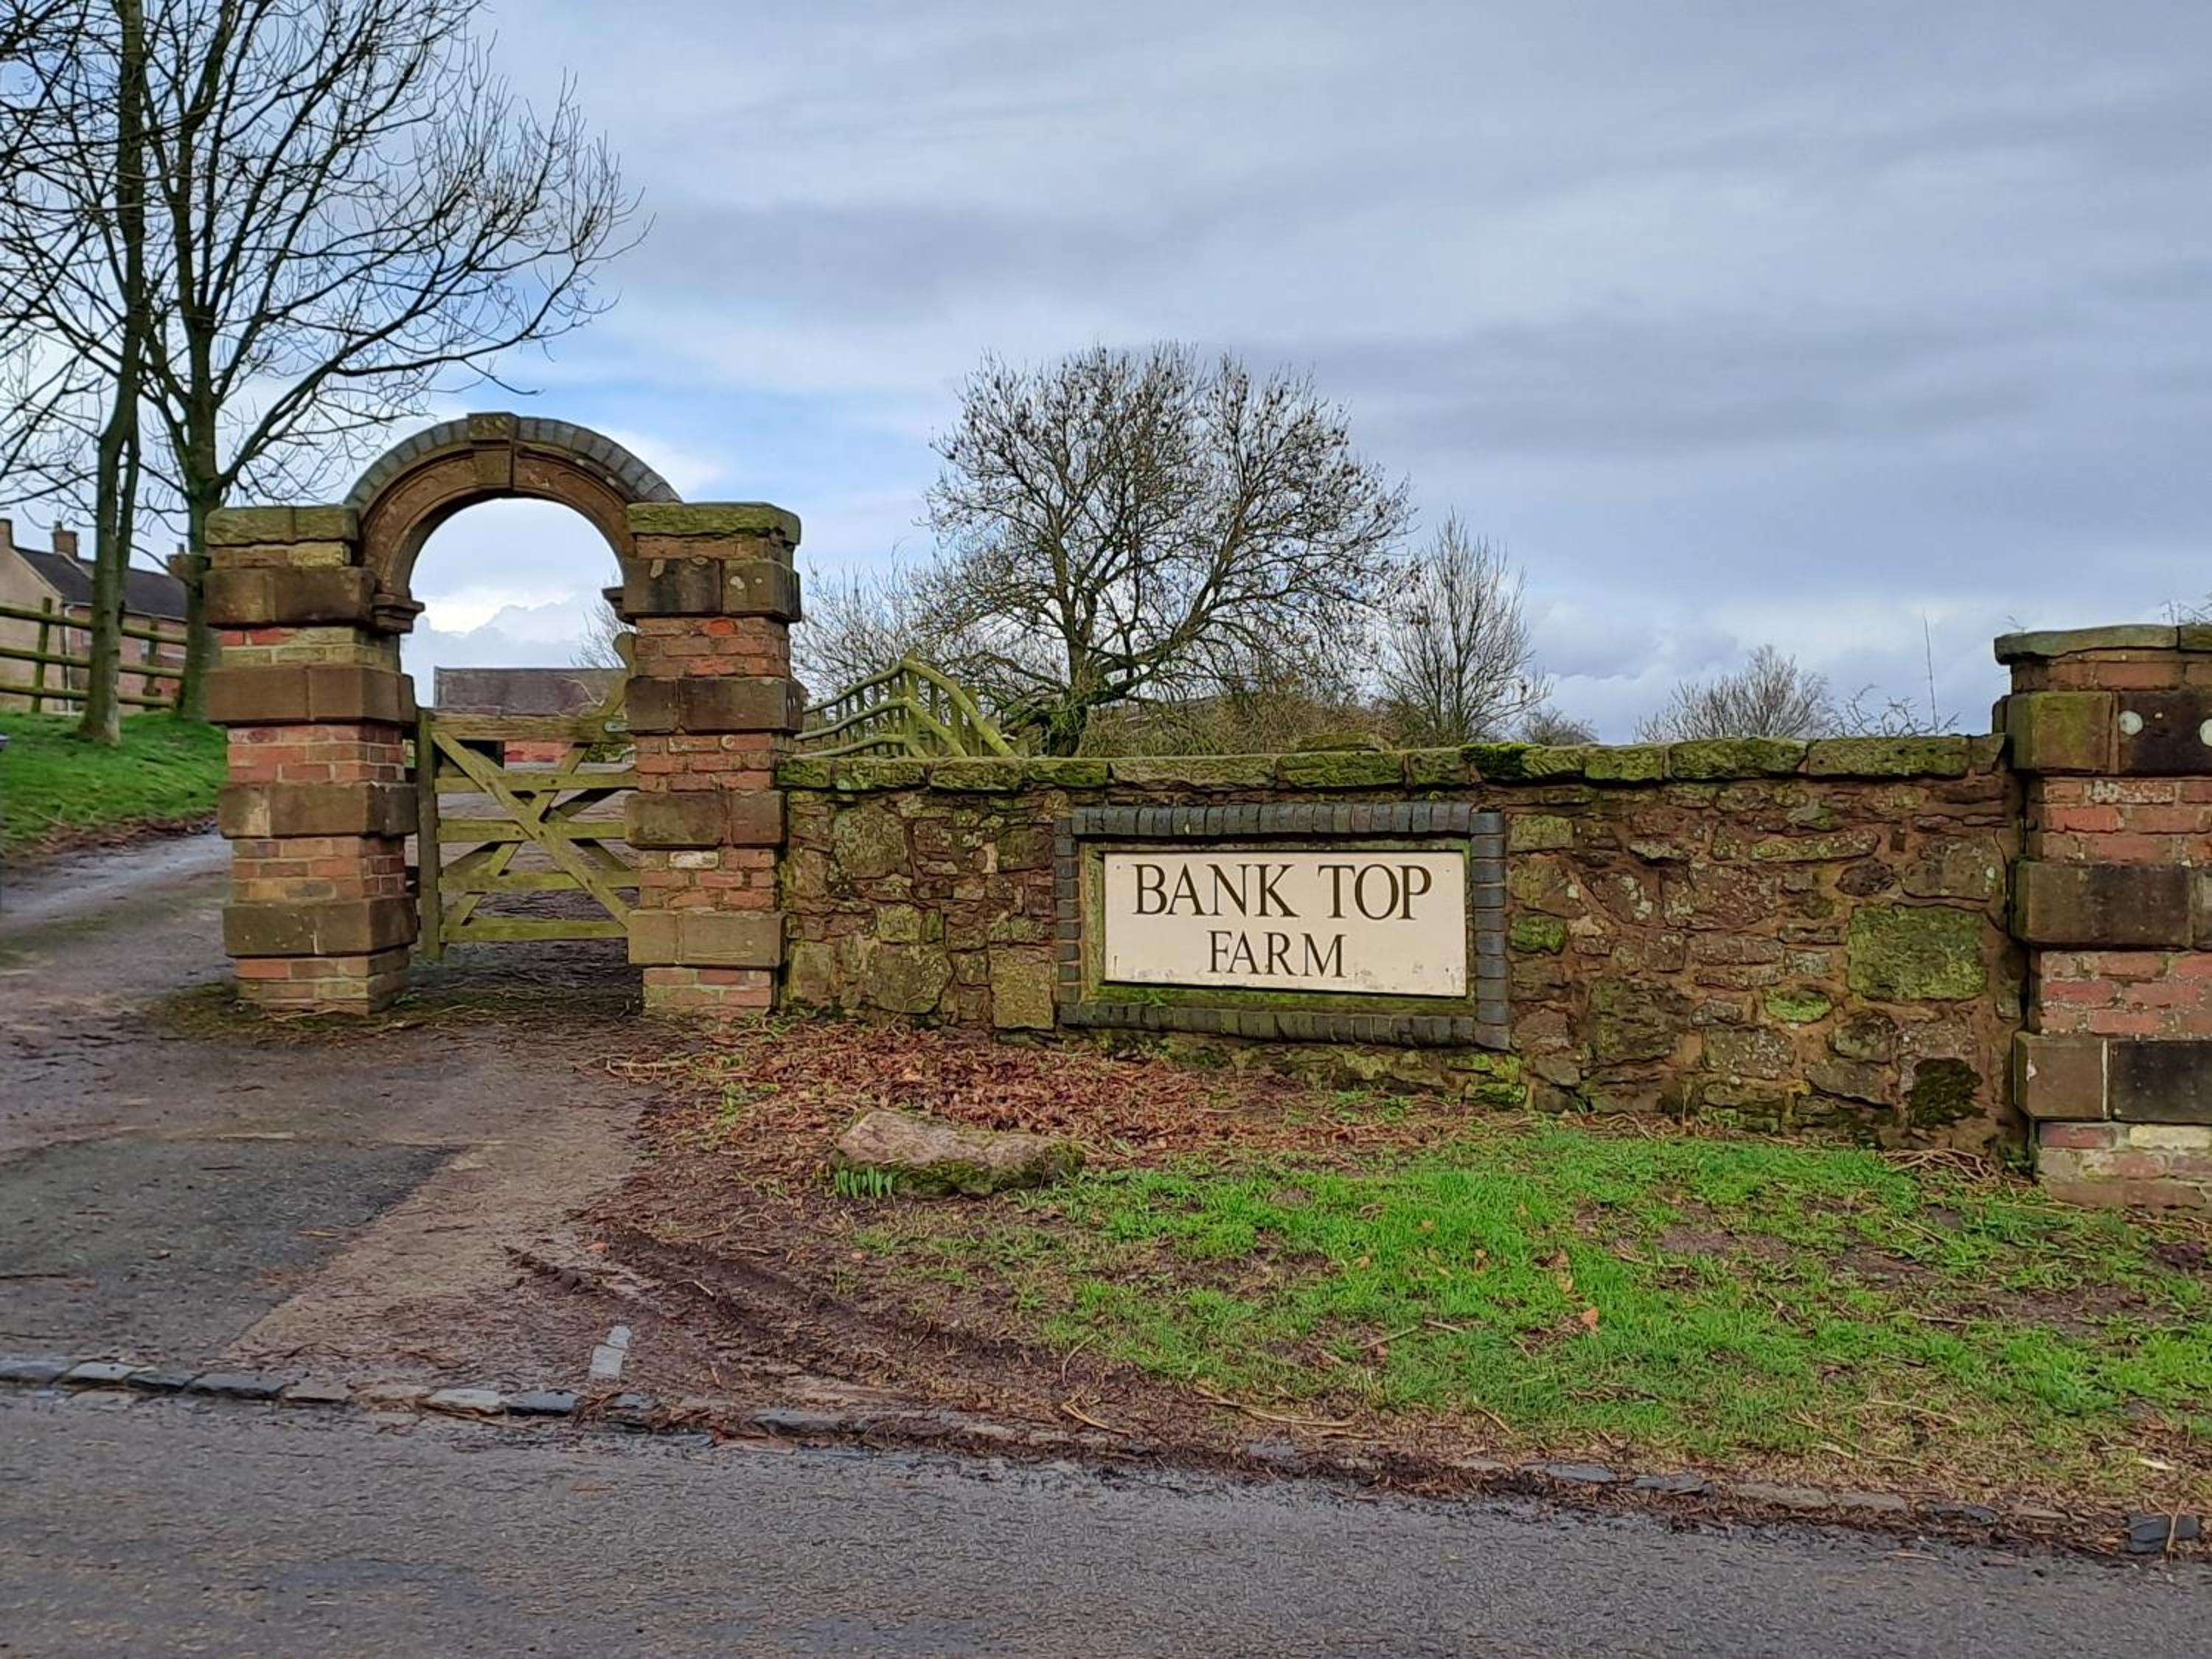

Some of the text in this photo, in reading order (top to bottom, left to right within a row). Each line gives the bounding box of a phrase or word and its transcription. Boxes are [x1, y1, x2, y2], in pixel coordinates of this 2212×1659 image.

[1133, 863, 1432, 920] BANK TOP
[1208, 930, 1346, 978] FARM
